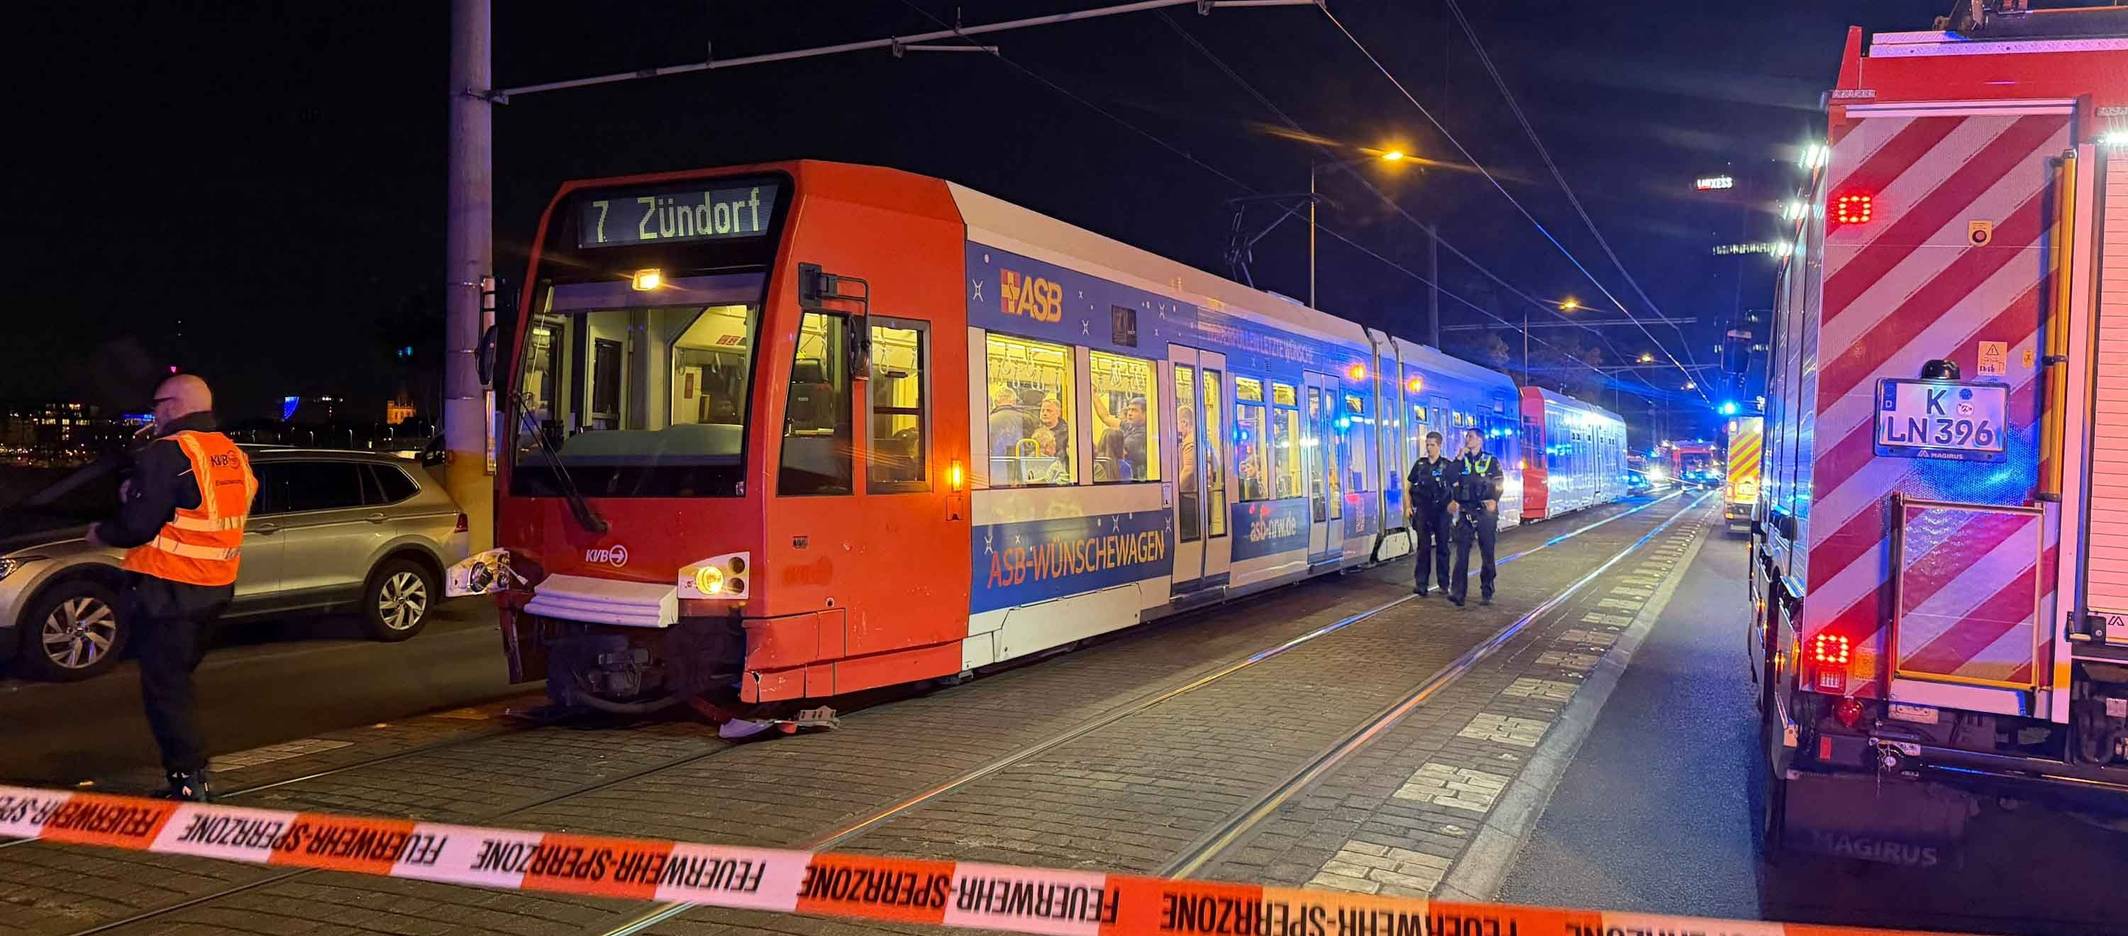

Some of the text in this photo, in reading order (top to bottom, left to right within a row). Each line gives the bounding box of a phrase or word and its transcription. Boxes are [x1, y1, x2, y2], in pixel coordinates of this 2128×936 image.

[592, 186, 760, 242] 7 Zündorf
[1017, 276, 1063, 323] ASB
[1885, 400, 1893, 408] D
[1926, 388, 1946, 416] K
[1887, 416, 1994, 446] LN 396
[1930, 452, 1964, 460] MAGIRUS
[1249, 506, 1297, 543] asb-nrw.de
[585, 549, 609, 563] KVB
[986, 530, 1165, 590] ASB-WÜNSCHEWAGEN
[177, 813, 447, 866] FEUERWEHR-SPERRZONE
[470, 839, 767, 893] FEUERWEHR-SPERRZONE
[797, 864, 1120, 924] FEUERWEHR-SPERRZONE
